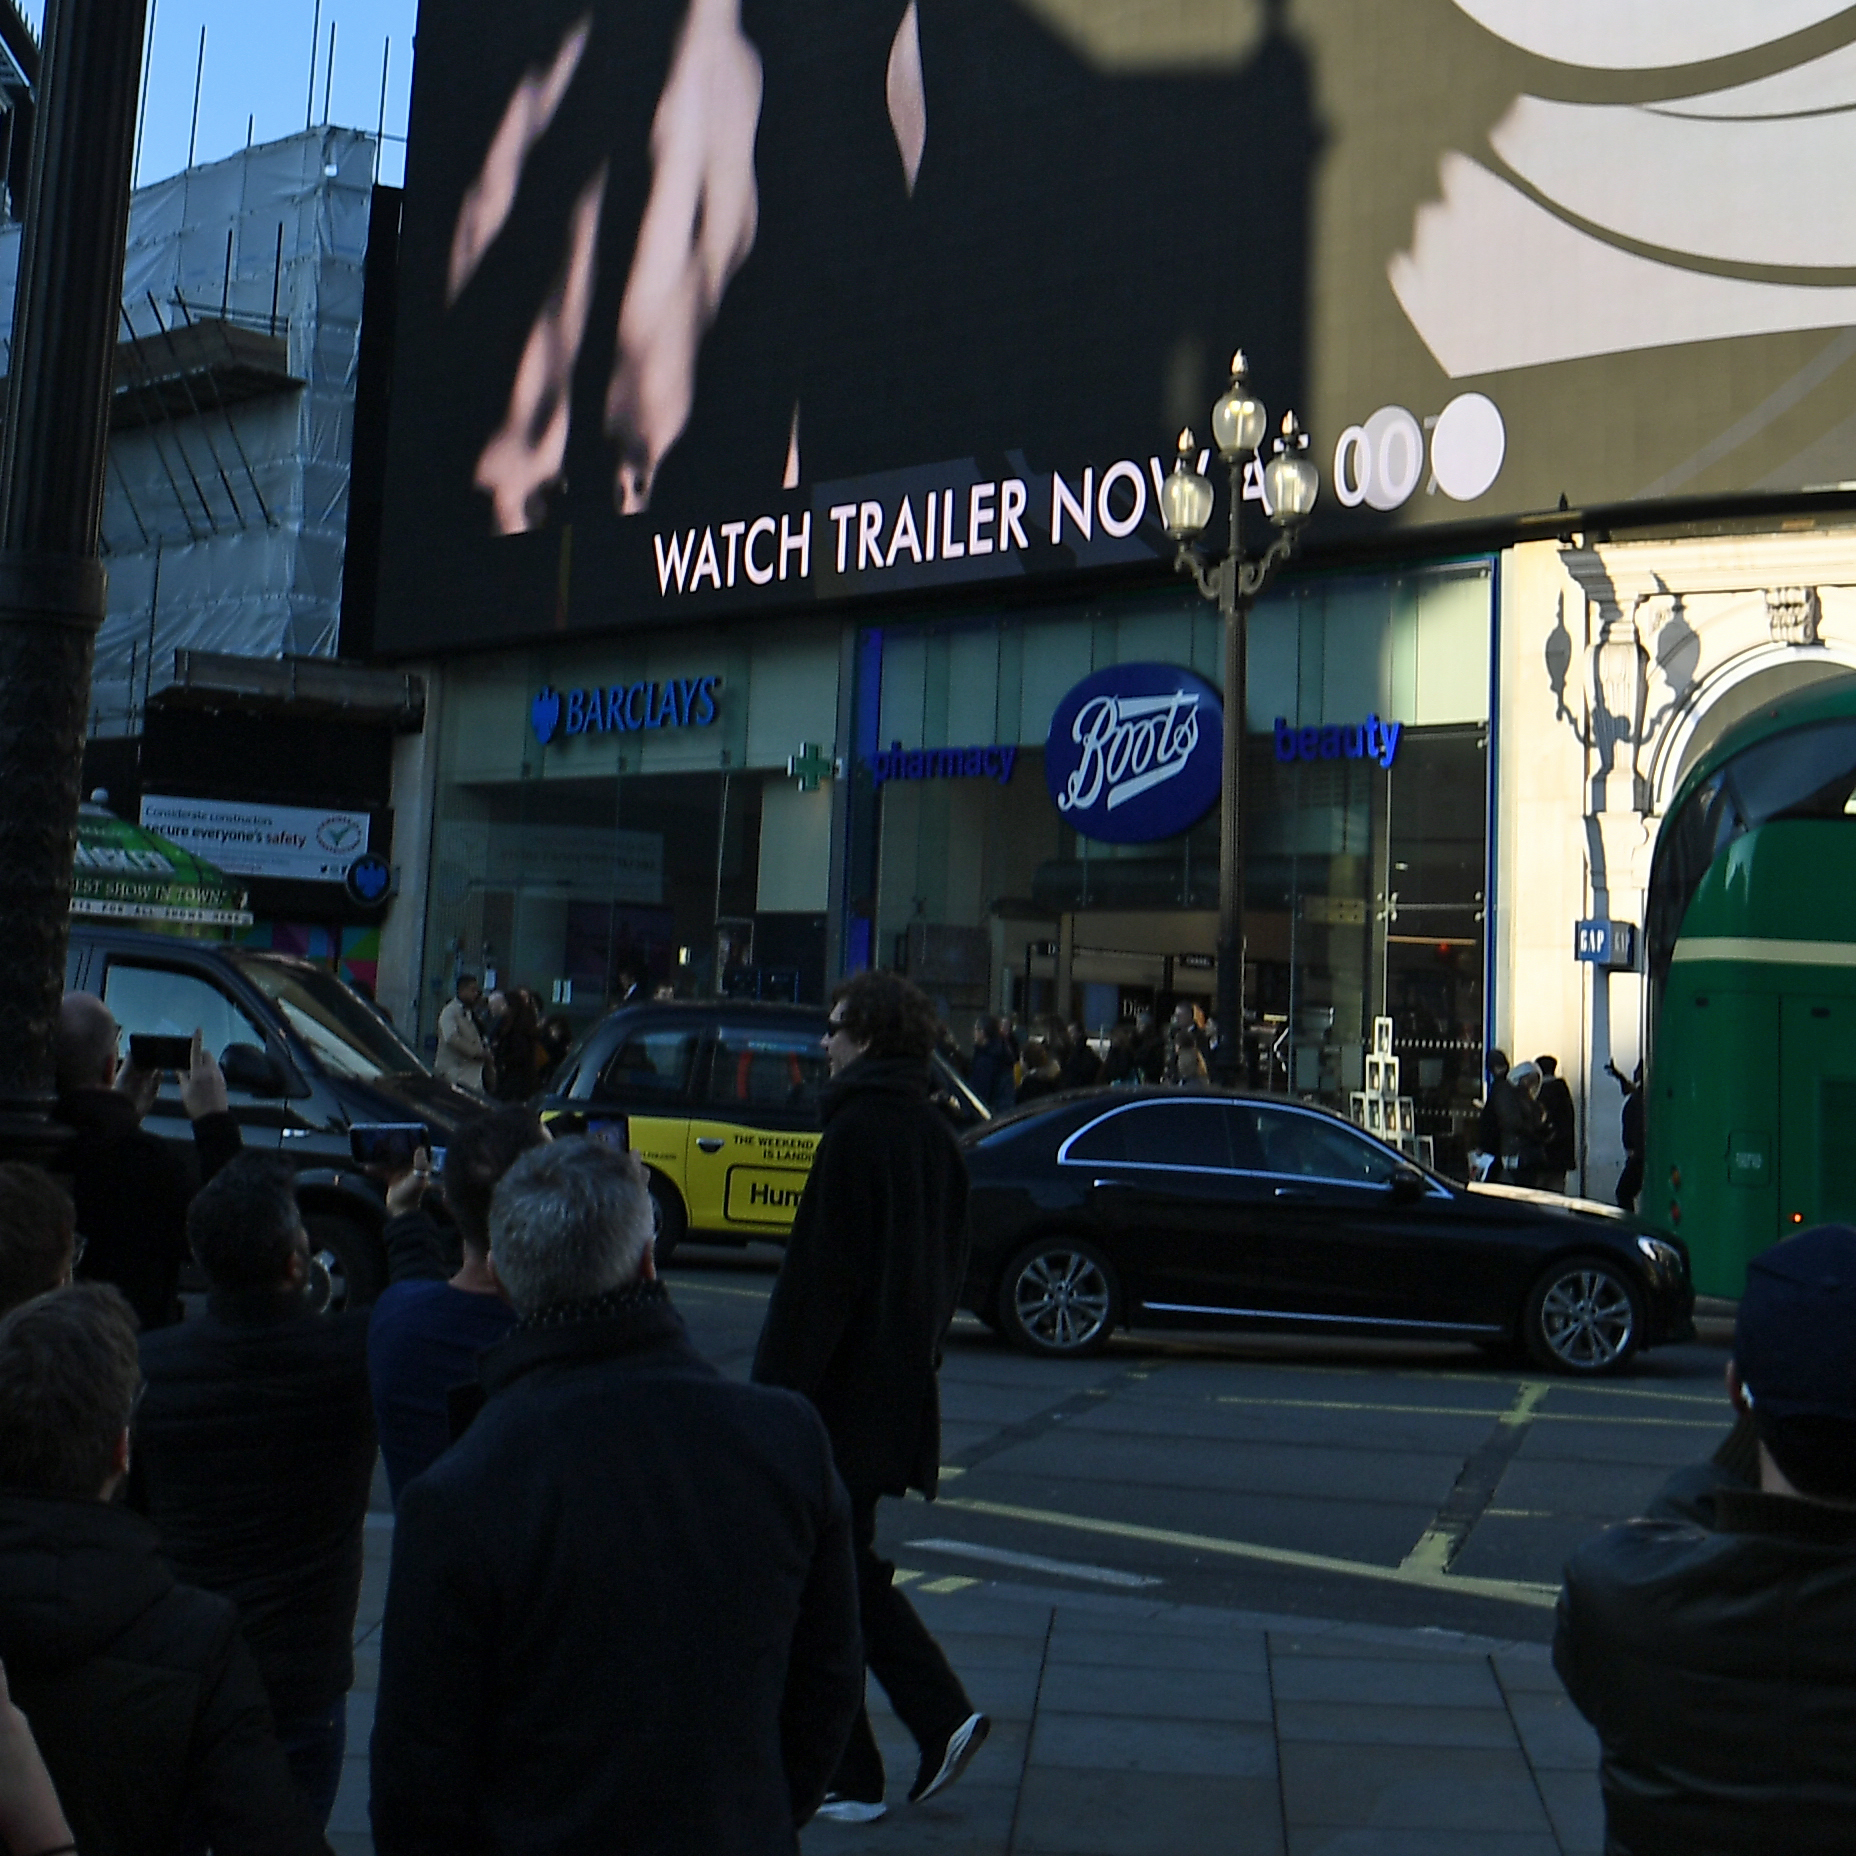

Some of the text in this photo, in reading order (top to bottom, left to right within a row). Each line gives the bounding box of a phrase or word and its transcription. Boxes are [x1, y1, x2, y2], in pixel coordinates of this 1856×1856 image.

[653, 510, 813, 598] WATCH
[830, 478, 1029, 574] TRAILER
[566, 676, 718, 735] BARCLAYS
[1057, 689, 1200, 813] Boots
[1273, 712, 1401, 769] beauty
[873, 741, 1017, 789] pharmacy
[192, 826, 262, 846] everyone's
[266, 831, 307, 849] safety
[105, 880, 150, 899] SHOW
[156, 885, 172, 901] IN
[1581, 929, 1604, 953] GAP
[734, 1135, 814, 1148] THE WEEKEND
